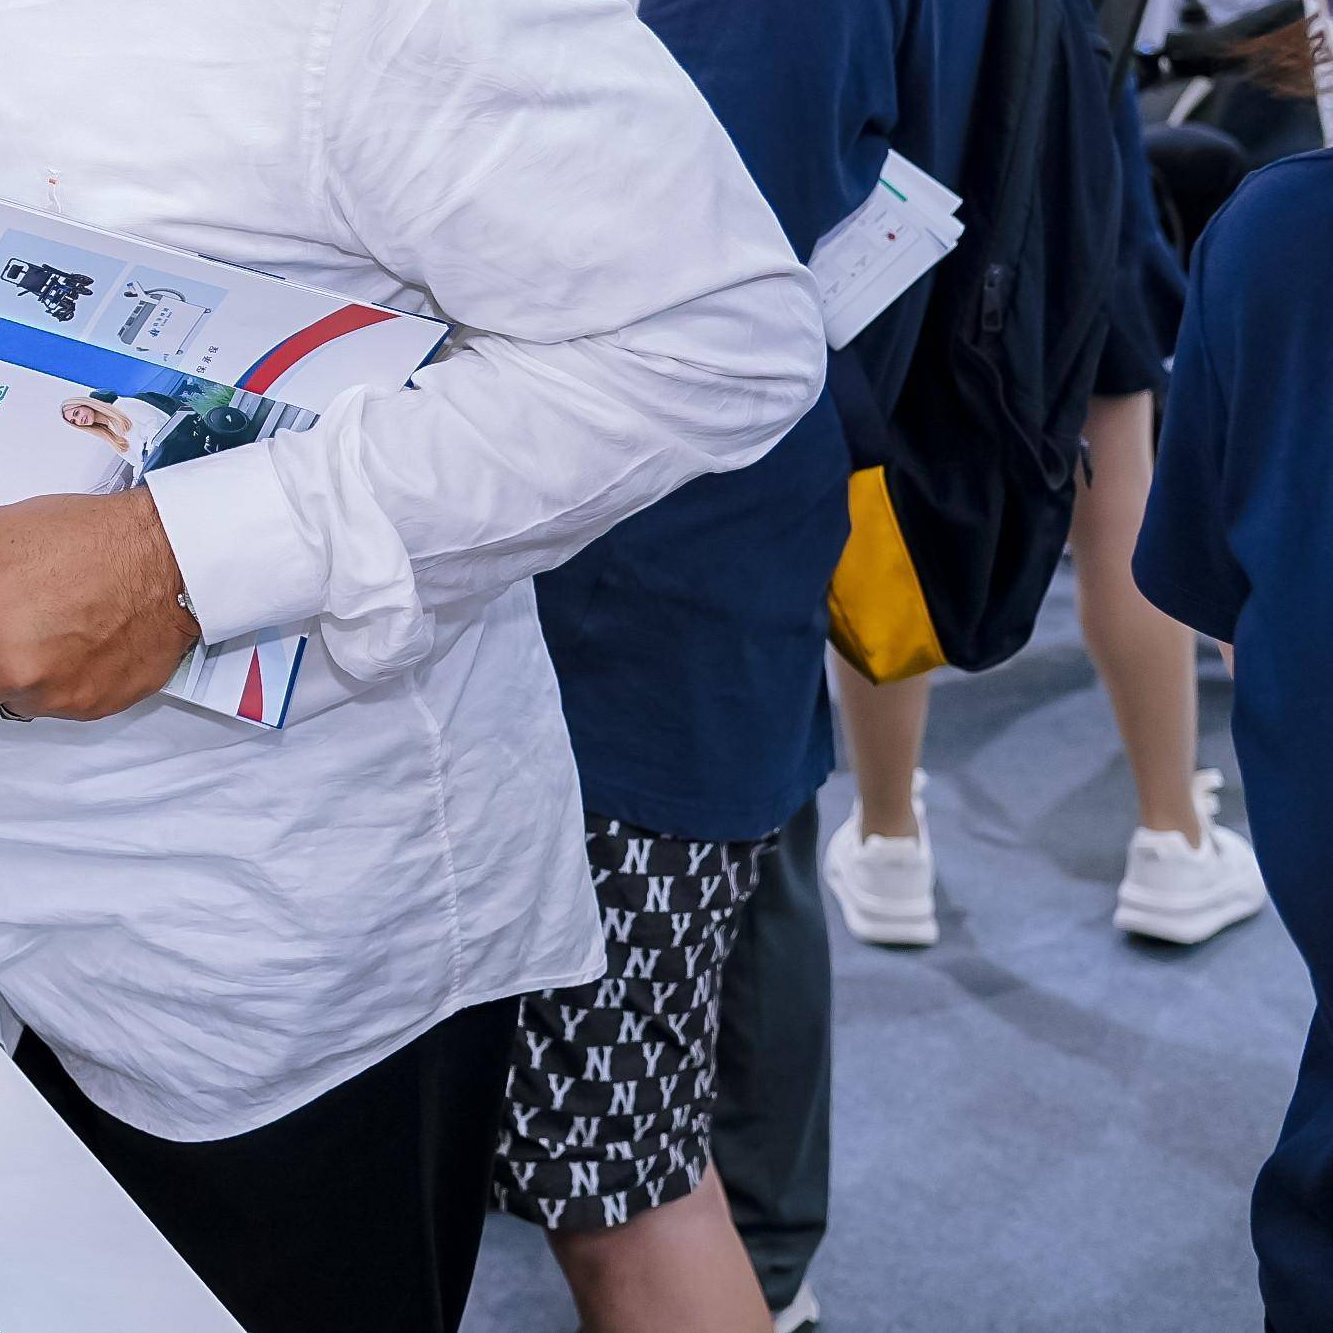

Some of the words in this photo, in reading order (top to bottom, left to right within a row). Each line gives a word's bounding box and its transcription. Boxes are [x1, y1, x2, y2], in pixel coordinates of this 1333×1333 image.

[620, 839, 653, 874] N
[644, 875, 674, 912] N
[603, 912, 637, 943] N
[625, 947, 661, 978] N
[595, 978, 627, 1007] N
[653, 982, 678, 1013] Y
[560, 1006, 589, 1042] Y
[617, 1012, 648, 1043] N
[527, 1031, 551, 1070] Y
[583, 1046, 613, 1081] N
[643, 1042, 664, 1077] Y
[549, 1074, 575, 1111] Y
[609, 1081, 638, 1115] N
[660, 1075, 678, 1110] Y
[513, 1103, 539, 1138] Y
[567, 1116, 601, 1147] N
[633, 1113, 655, 1141] Y
[510, 1162, 536, 1192] Y
[569, 1162, 600, 1197] N
[636, 1156, 656, 1186] Y
[539, 1198, 566, 1228] Y
[603, 1195, 628, 1226] N
[646, 1179, 664, 1208] Y
